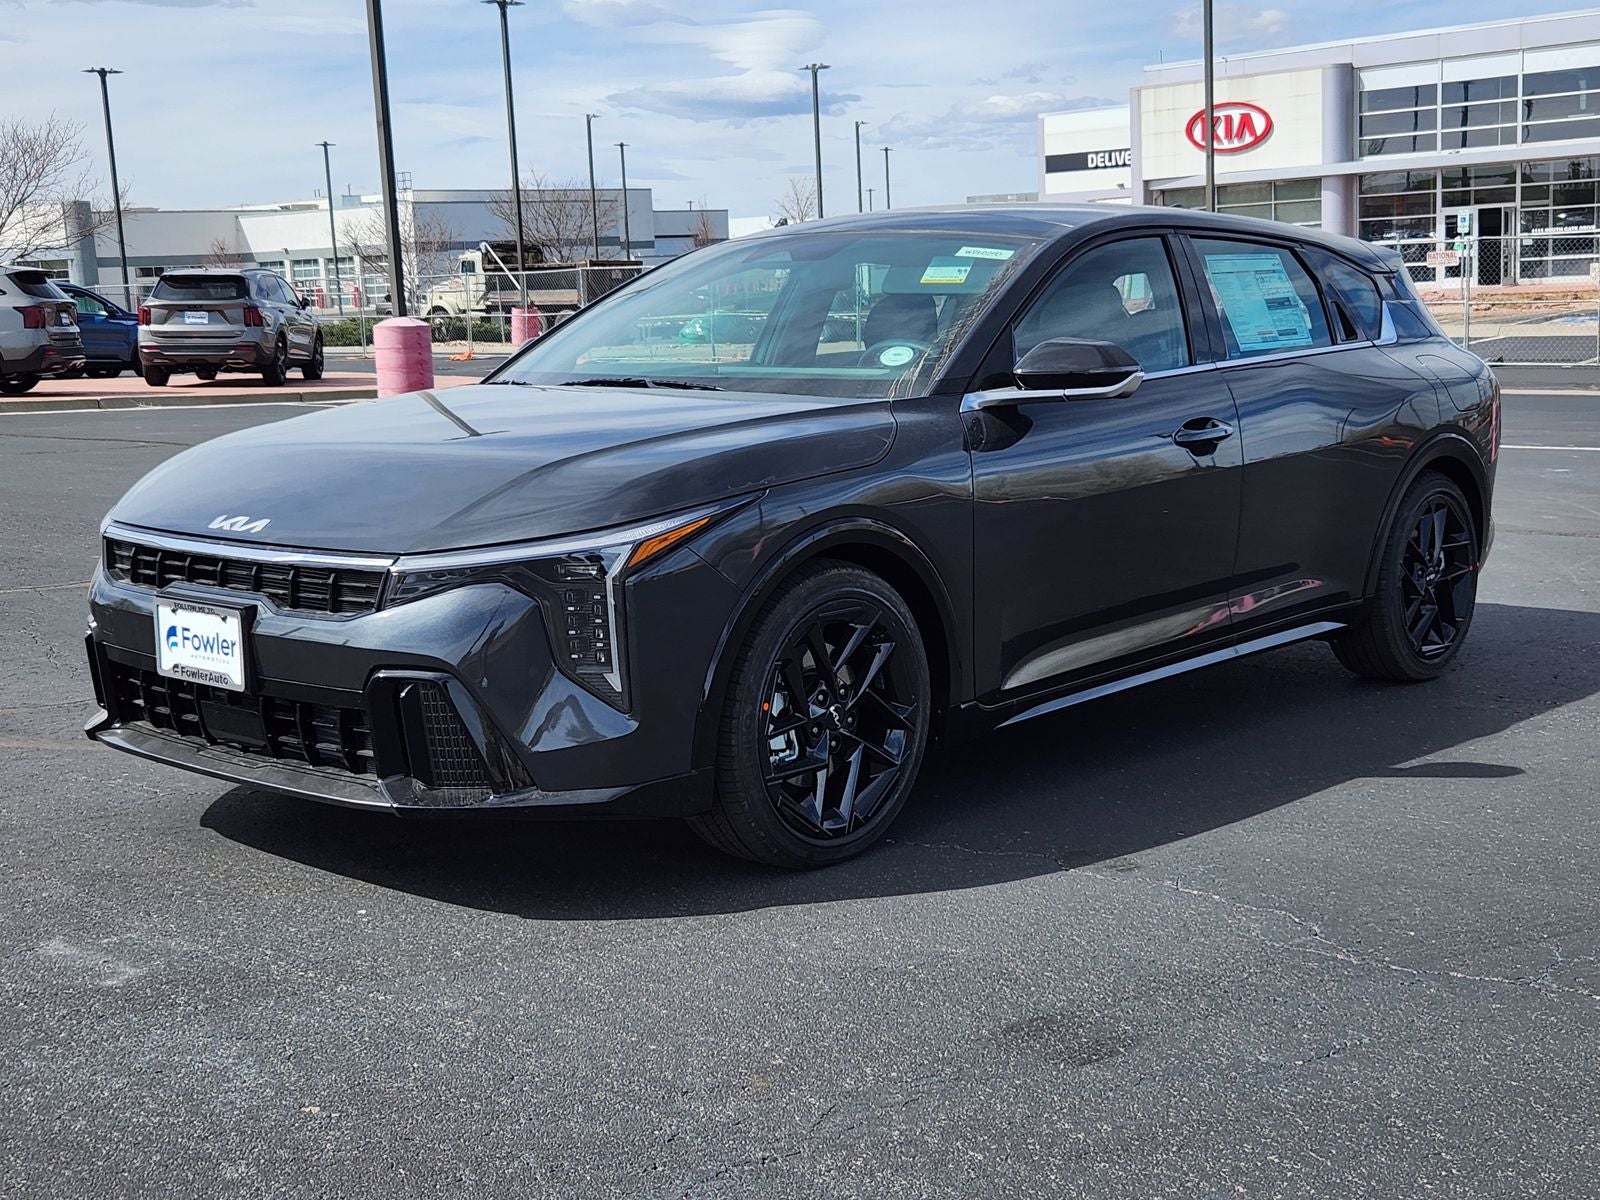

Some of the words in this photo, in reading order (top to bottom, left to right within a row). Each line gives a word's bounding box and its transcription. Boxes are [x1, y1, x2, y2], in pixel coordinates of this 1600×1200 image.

[1200, 112, 1258, 144] KIA
[1427, 251, 1457, 260] NATIONAL
[173, 602, 196, 612] FOLLOW
[181, 626, 236, 657] Fowler
[190, 654, 229, 665] AUTOMOTIVE
[180, 666, 229, 685] FowlerAuto
